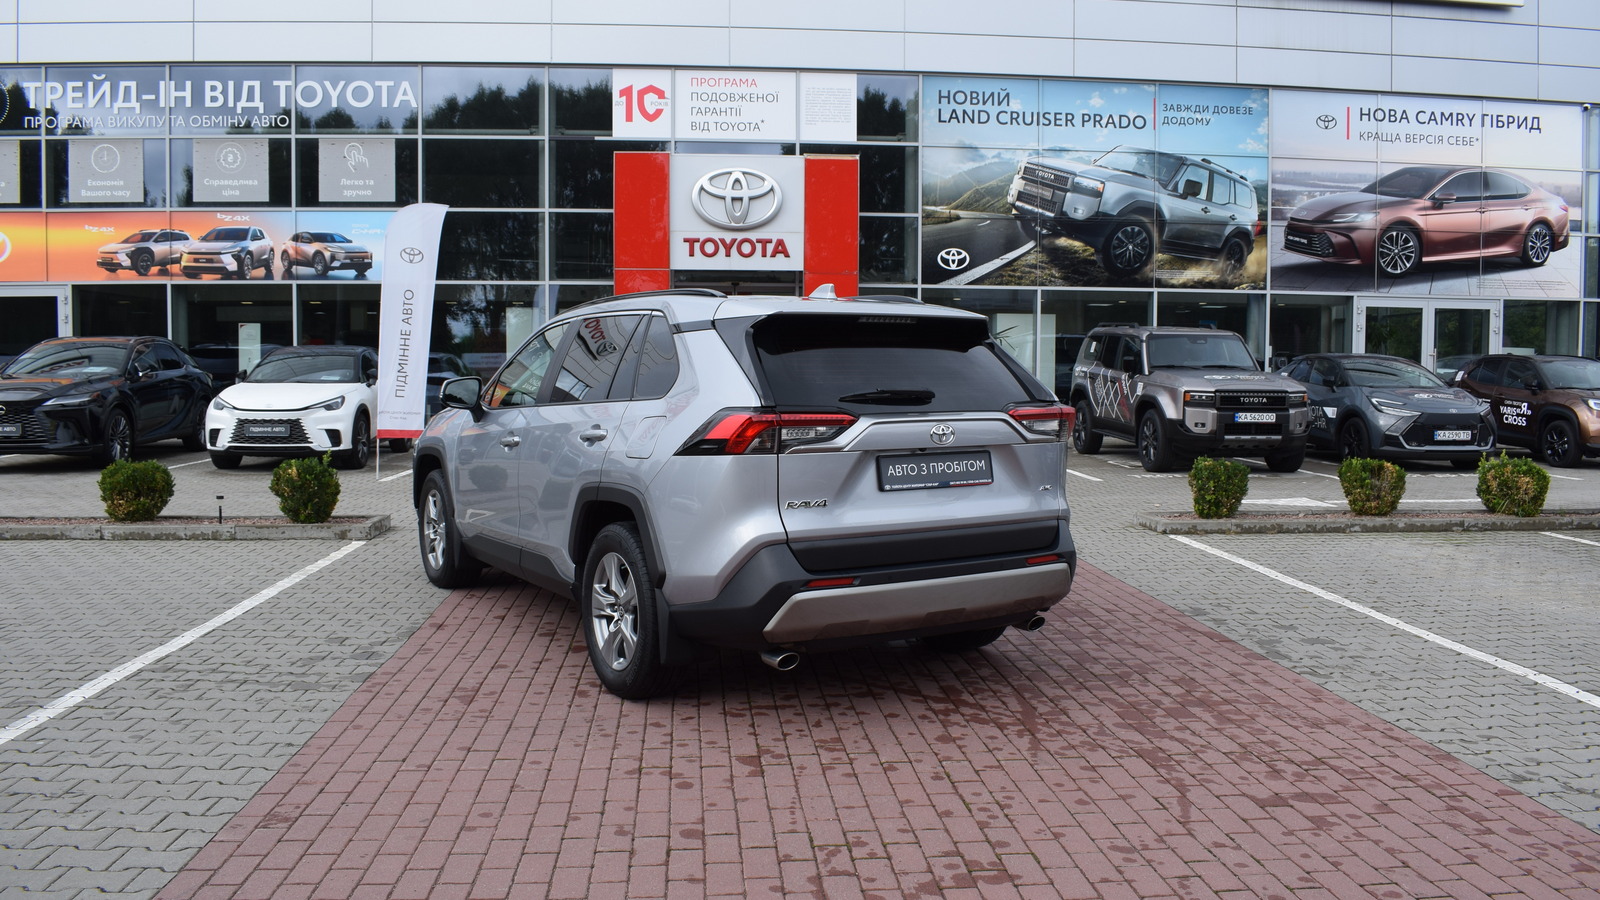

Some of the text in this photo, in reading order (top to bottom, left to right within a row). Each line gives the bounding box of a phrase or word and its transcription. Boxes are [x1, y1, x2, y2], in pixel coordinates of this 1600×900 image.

[691, 77, 757, 88] ПРОГРАМА
[23, 74, 418, 114] ТРЕЙД-ІН ВІД TOYOTA
[690, 91, 779, 104] ПОДОВЖЕНОЇ
[938, 88, 1010, 107] НОВИЙ
[690, 105, 742, 117] ГАРАНТІЇ
[1162, 103, 1254, 117] ЗАВЖДИ ДОВЕЗЕ
[25, 114, 290, 129] ПРОГРАМА ВИКУПУ ТА ОБМІНУ АВТО
[937, 108, 1147, 130] LAND CRUISER PRADO
[1161, 116, 1212, 127] ДОДОМУ
[1359, 107, 1542, 134] НОВА CAMRY ГІБРИД
[690, 121, 711, 133] ВІД
[1359, 131, 1401, 144] КРАЩА
[1405, 133, 1444, 145] ВЕРСІЯ
[1035, 170, 1055, 179] TOYOTA
[204, 178, 258, 186] Справедлива
[340, 178, 364, 186] Легко
[222, 188, 240, 197] ціна
[343, 189, 372, 197] зручно
[683, 237, 790, 258] TOYOTA
[401, 289, 415, 326] АВТО
[395, 329, 412, 398] ПІДМІННЕ
[1499, 405, 1516, 415] YARIS
[1249, 413, 1264, 421] 5620
[1503, 414, 1527, 426] CROSS
[887, 464, 918, 477] АВТО
[929, 460, 986, 474] ПРОБІГОМ
[784, 498, 828, 510] RAV4
